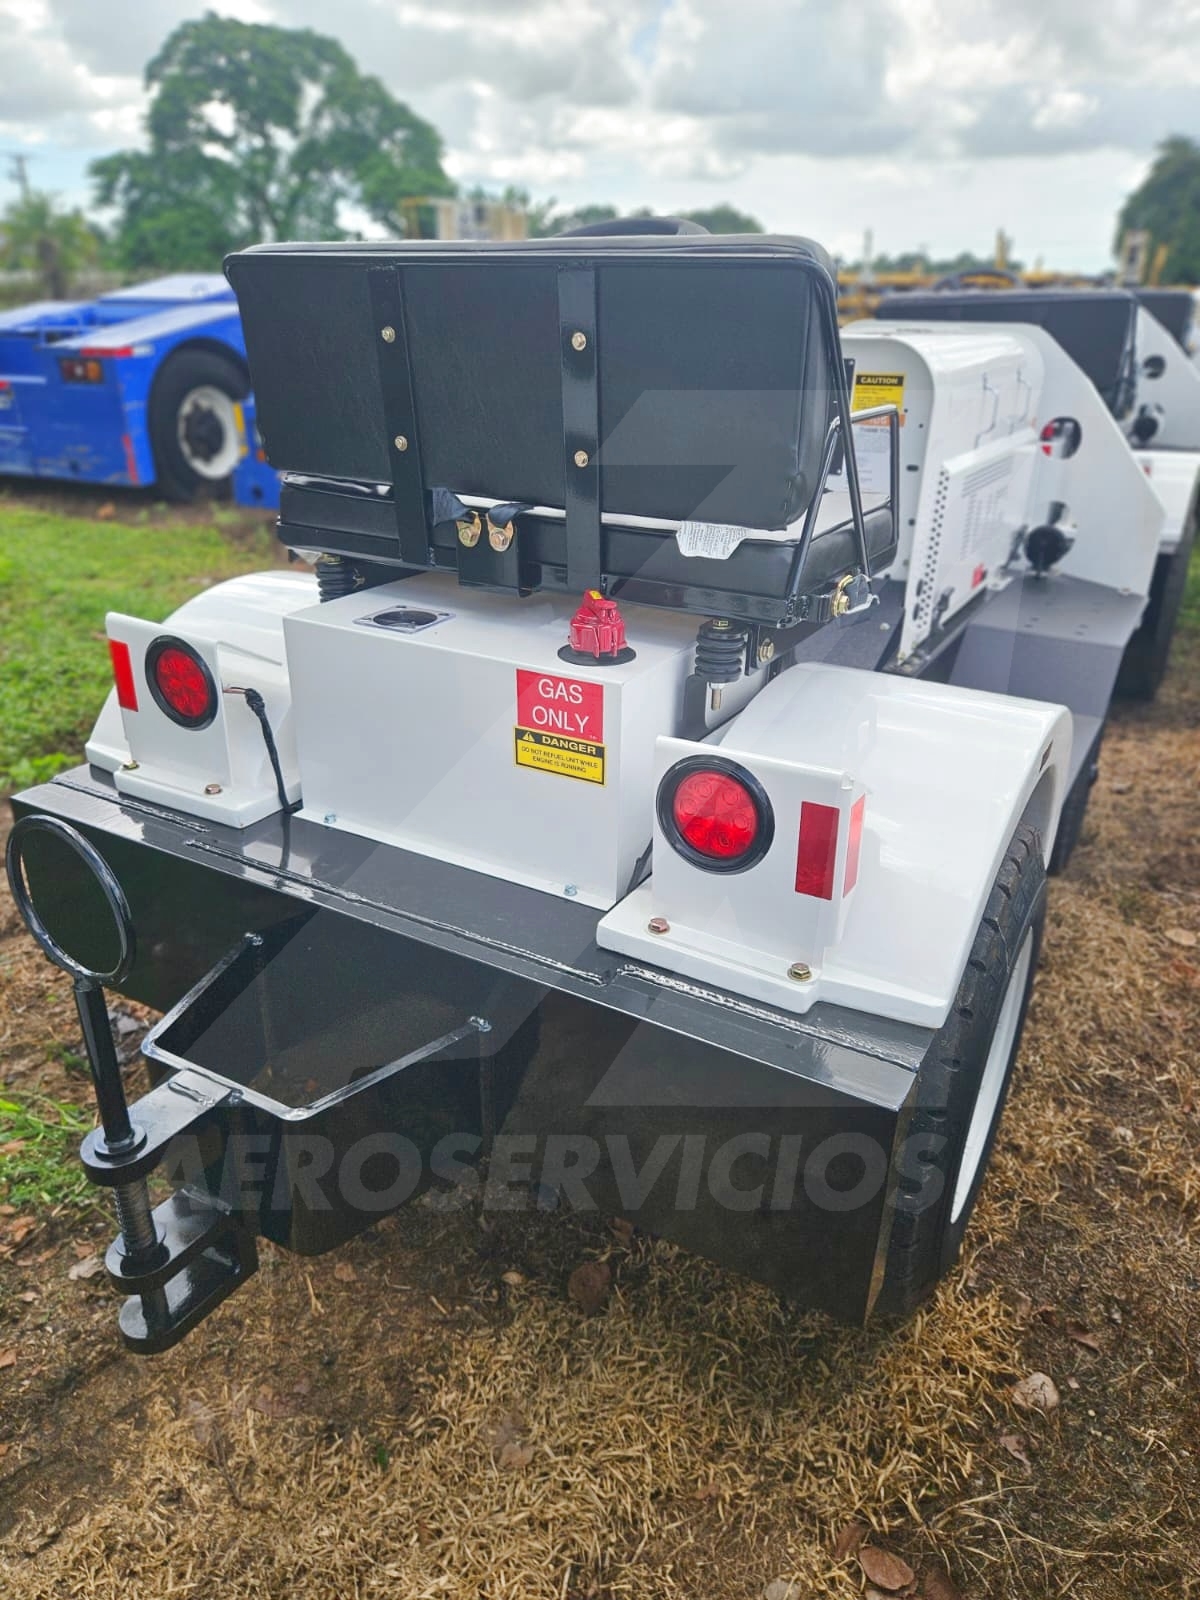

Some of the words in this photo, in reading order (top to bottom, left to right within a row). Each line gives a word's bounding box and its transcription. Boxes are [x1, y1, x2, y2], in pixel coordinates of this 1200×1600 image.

[860, 377, 898, 385] CAUTION
[538, 678, 583, 704] GAS
[532, 705, 589, 734] ONLY
[542, 736, 596, 755] DANGER
[531, 748, 542, 756] NOT
[543, 751, 564, 761] REFUEL
[566, 755, 579, 764] UNIT
[579, 759, 598, 768] WHILE
[532, 756, 553, 765] ENGINE
[560, 762, 587, 773] RUNNING
